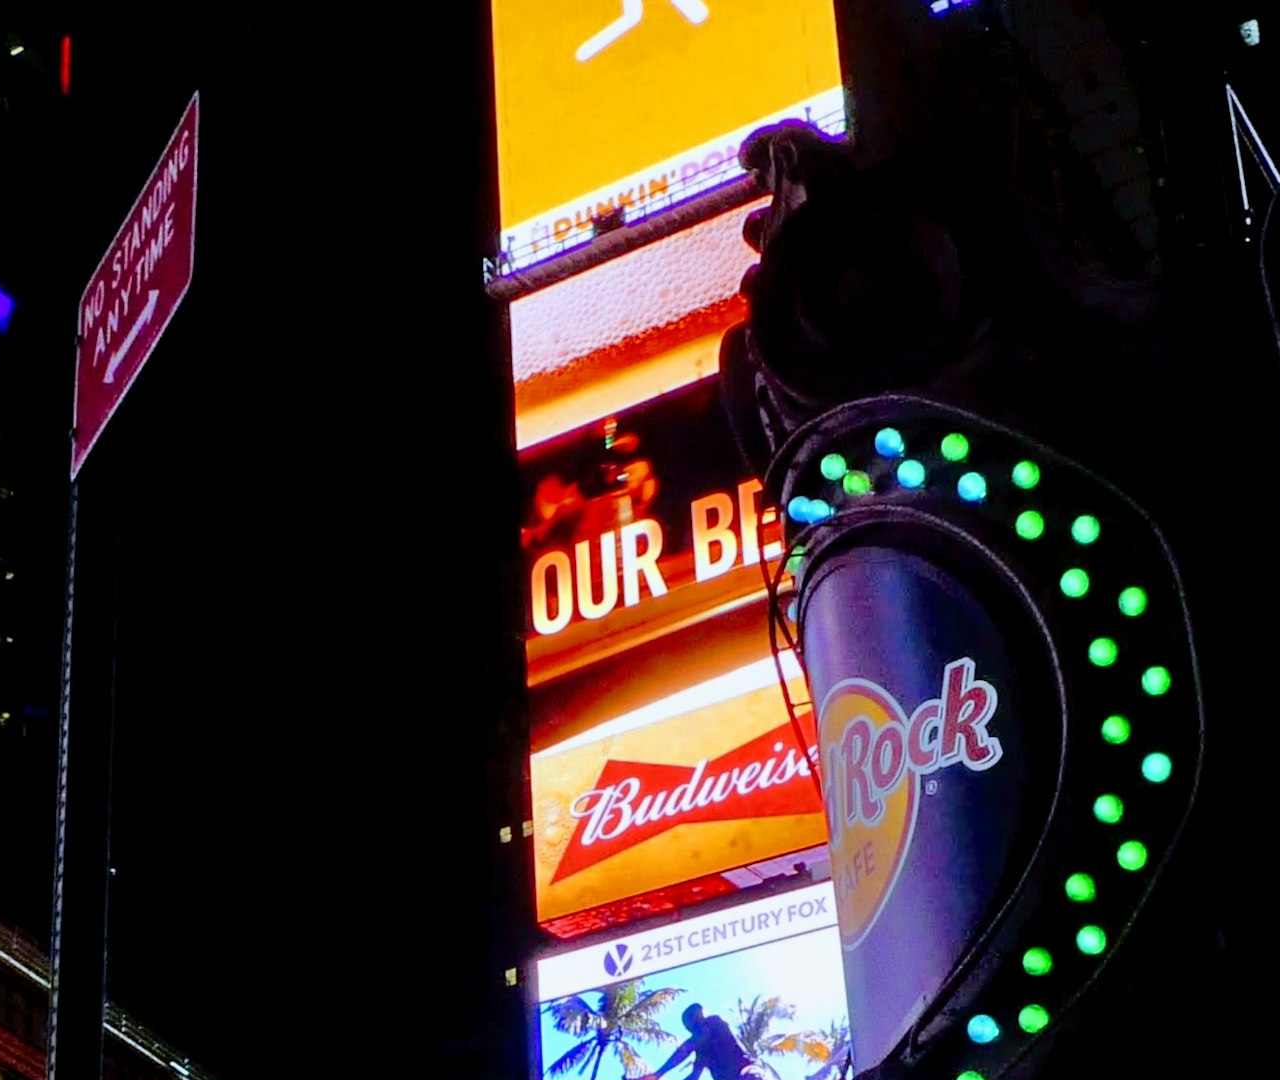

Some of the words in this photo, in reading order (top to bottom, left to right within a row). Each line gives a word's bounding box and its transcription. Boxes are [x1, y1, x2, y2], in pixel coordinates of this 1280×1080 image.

[83, 280, 105, 339] NO
[111, 130, 189, 289] STANDING
[530, 516, 668, 637] OUR
[568, 740, 822, 846] Budweise
[839, 656, 1005, 828] Rock
[640, 934, 685, 962] 21ST
[687, 906, 784, 949] CENTURY
[787, 896, 829, 923] FOX
